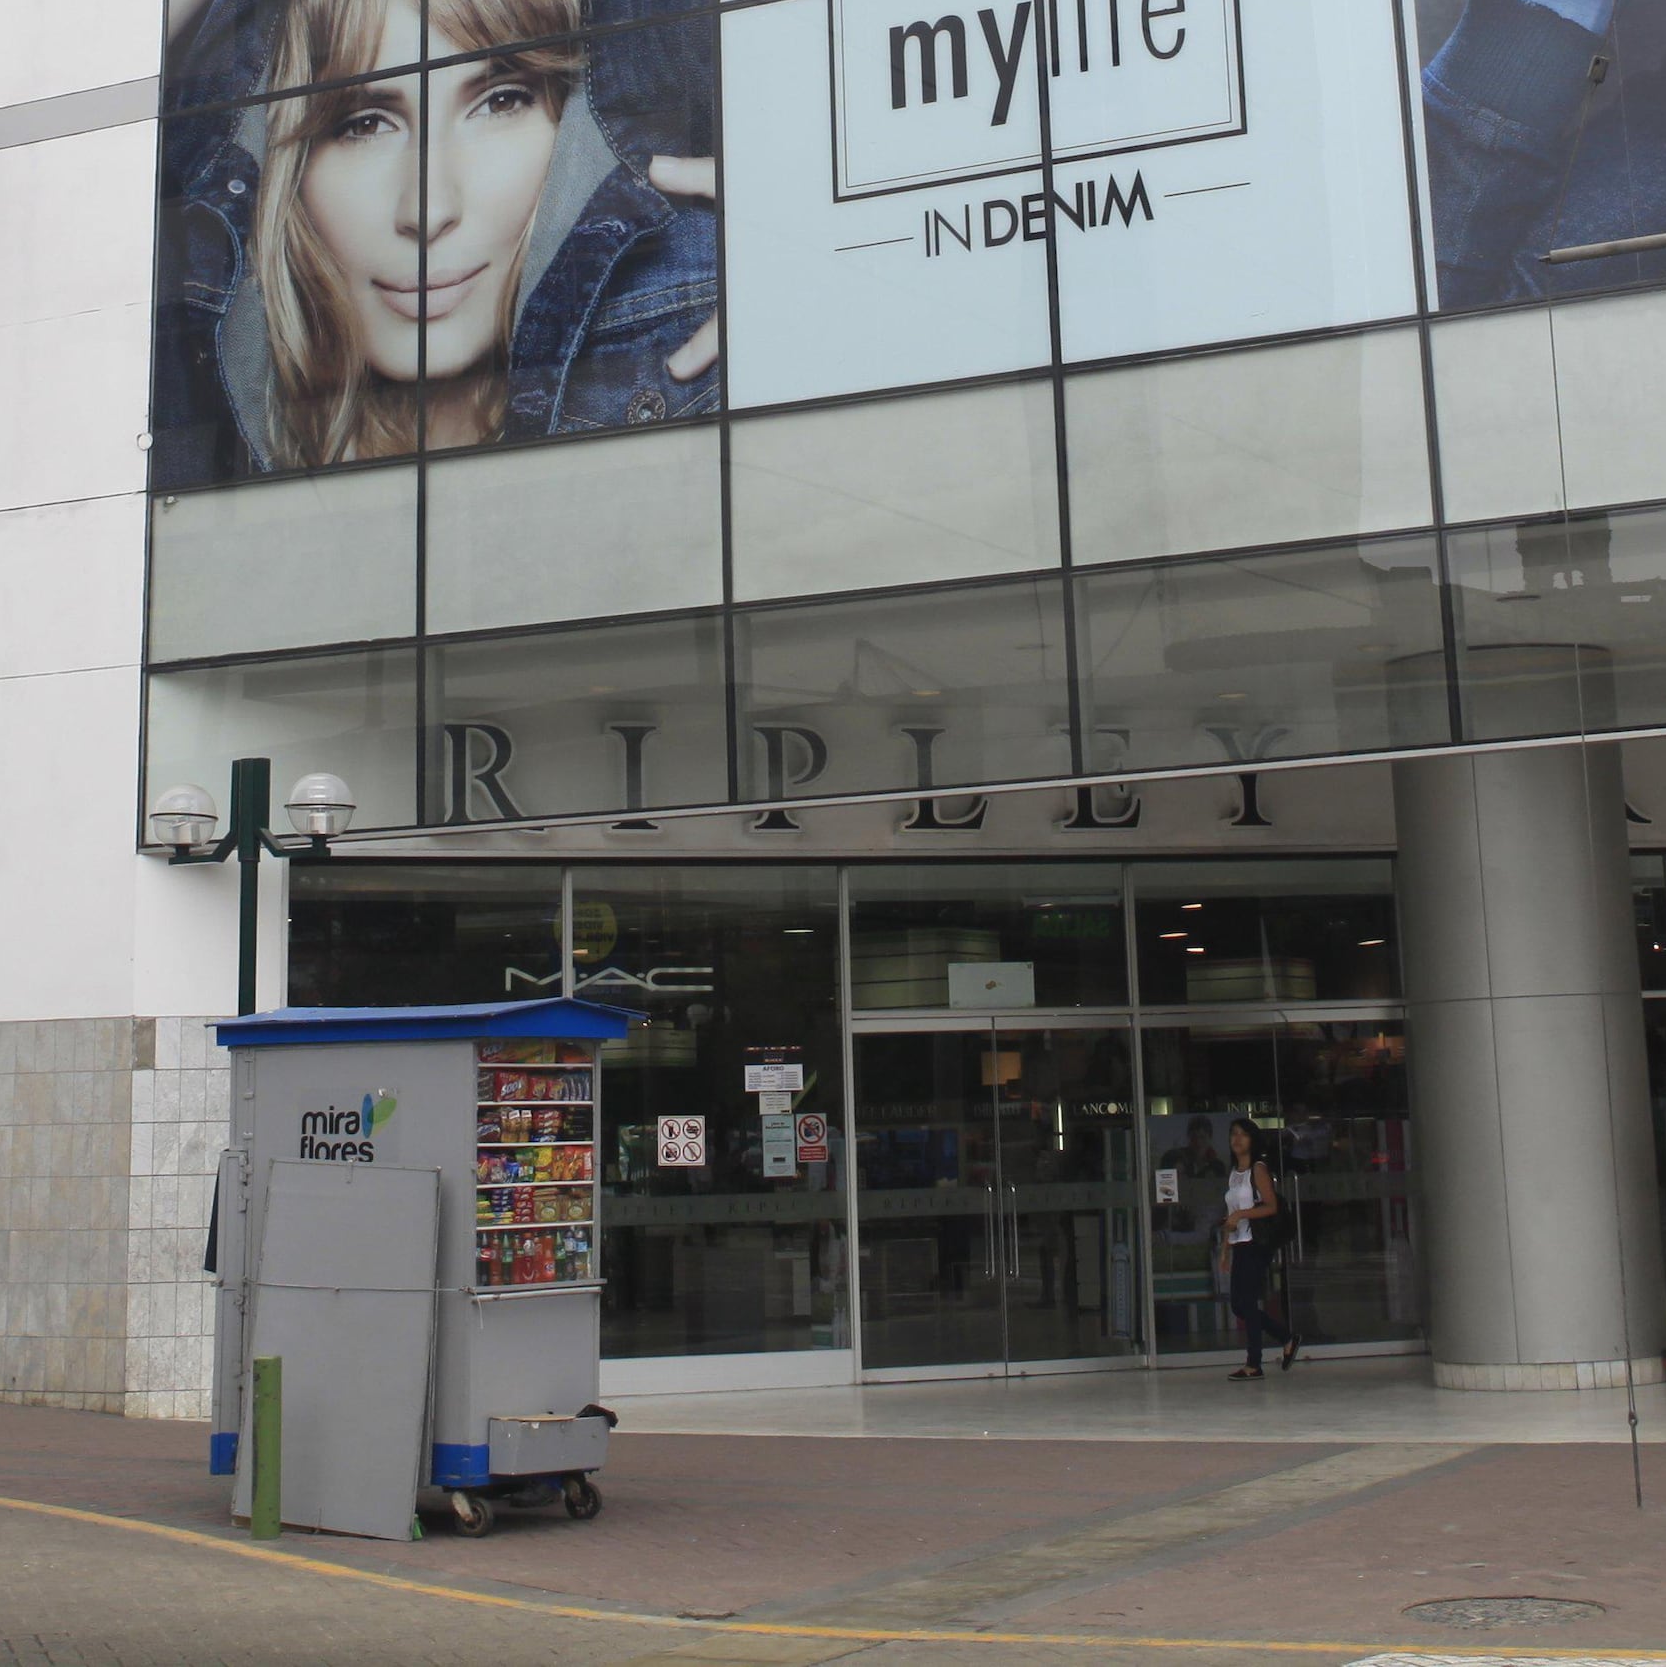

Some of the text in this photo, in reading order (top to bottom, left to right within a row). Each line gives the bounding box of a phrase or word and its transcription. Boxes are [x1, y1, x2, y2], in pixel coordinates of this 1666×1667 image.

[923, 168, 1155, 258] IN DENIM
[441, 720, 1291, 834] RIPLEY
[300, 1135, 374, 1162] flores
[301, 1105, 361, 1135] mira
